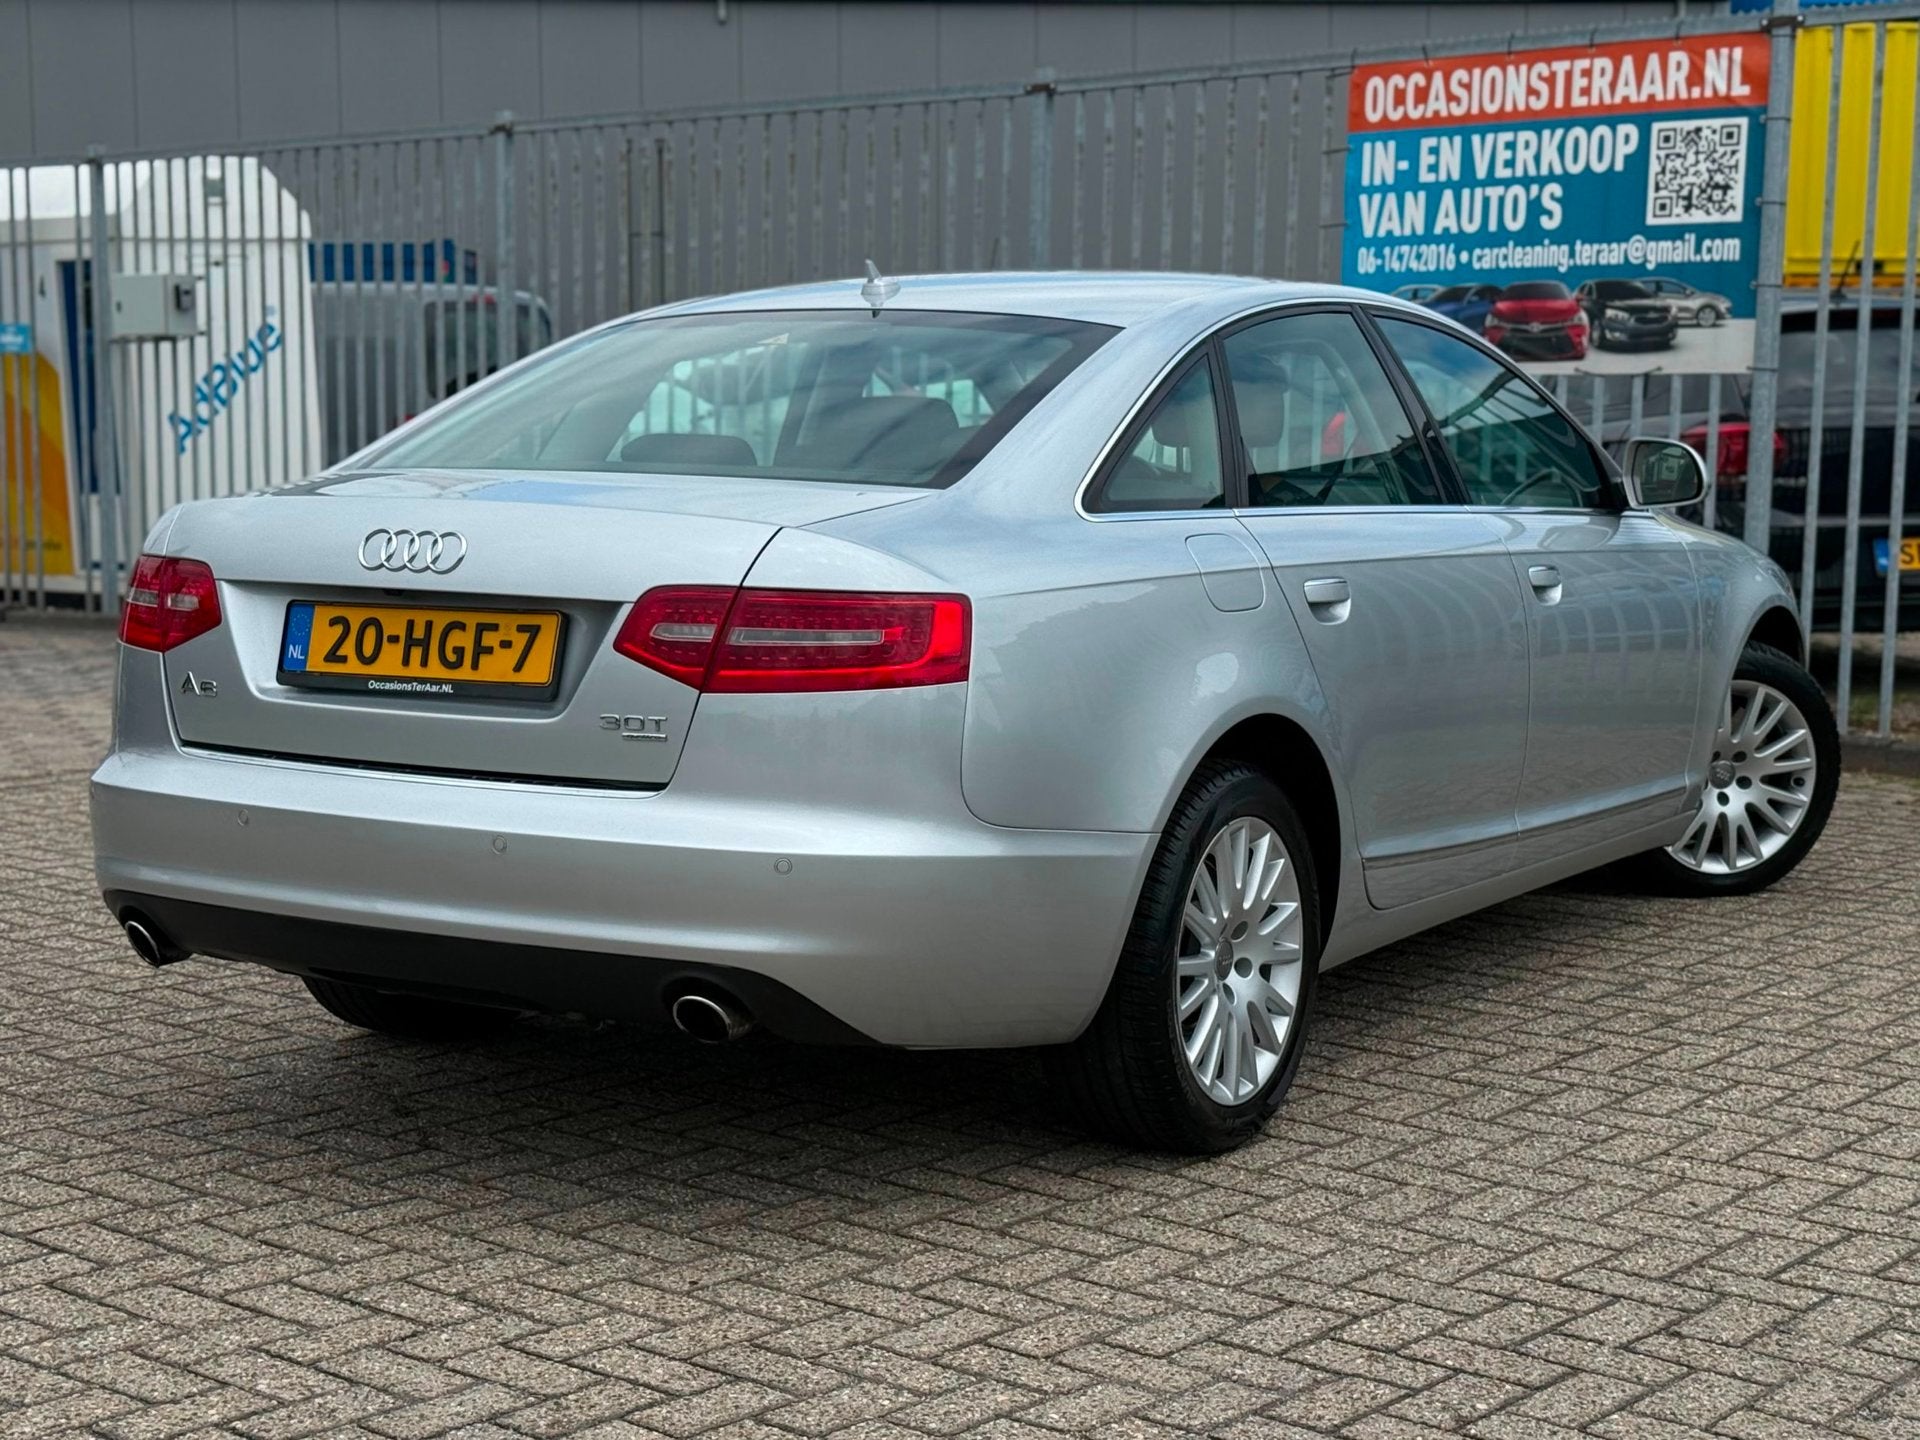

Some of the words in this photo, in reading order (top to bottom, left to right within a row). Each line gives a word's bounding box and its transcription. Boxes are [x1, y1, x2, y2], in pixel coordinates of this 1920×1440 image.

[1364, 47, 1751, 123] OCCASIONSTERAAR.NL
[1361, 139, 1410, 187] IN-
[1418, 136, 1462, 183] EN
[1471, 123, 1640, 180] VERKOOP
[1358, 191, 1426, 238] VAN
[1433, 182, 1564, 235] AUTO'S
[1357, 243, 1456, 274] 06-14742016
[1472, 233, 1742, 273] carcleaning.teraar@gmail.com
[1900, 543, 1920, 566] S
[288, 644, 305, 660] NL
[323, 615, 542, 673] 20-HGF-7
[181, 670, 217, 697] A6
[367, 679, 454, 694] OccasionsTerAar.NL
